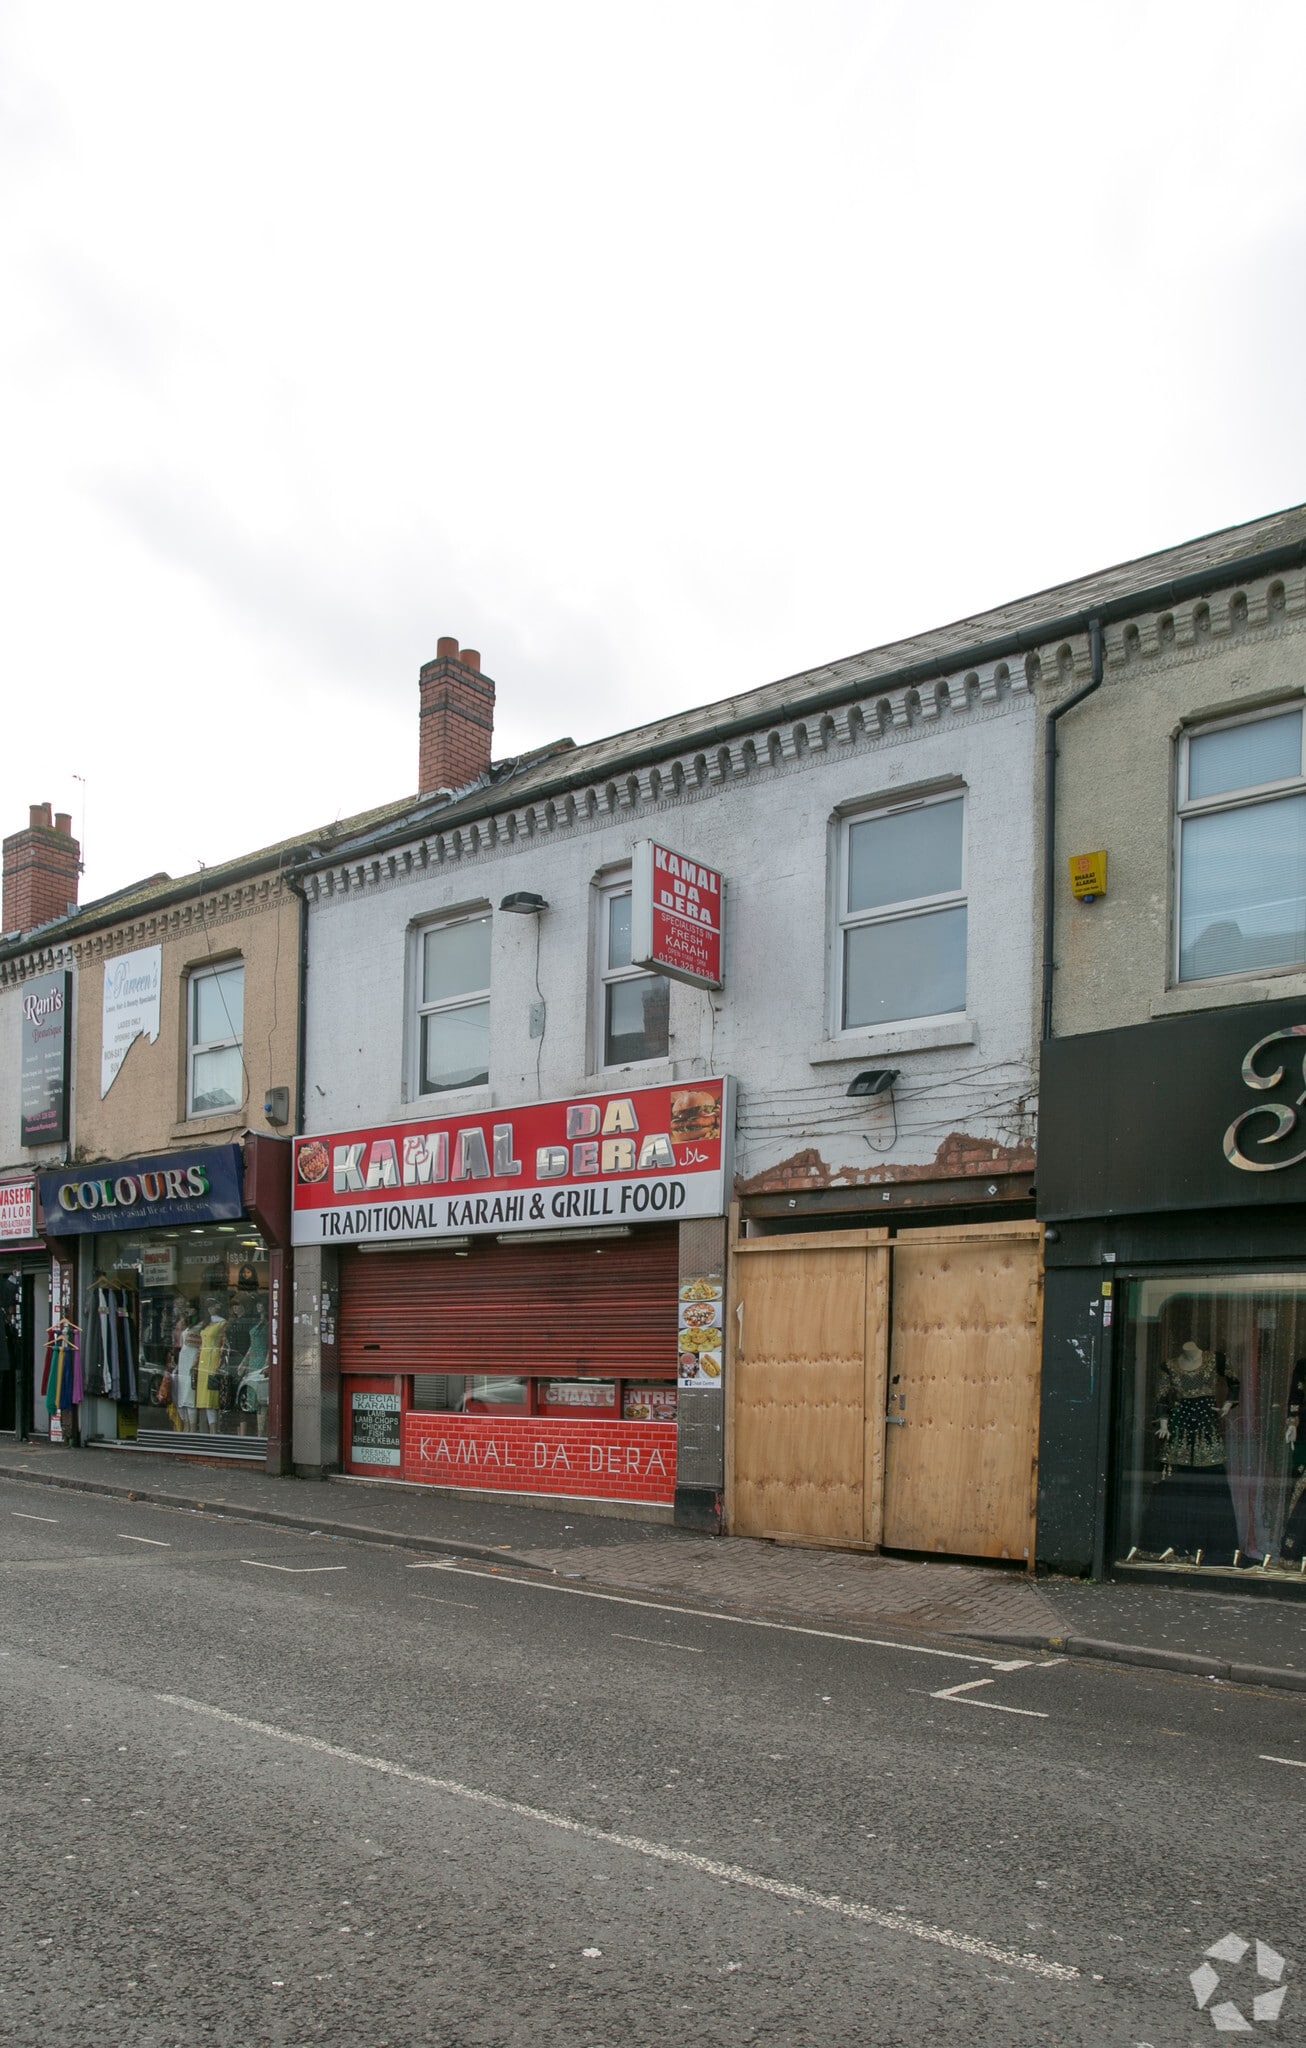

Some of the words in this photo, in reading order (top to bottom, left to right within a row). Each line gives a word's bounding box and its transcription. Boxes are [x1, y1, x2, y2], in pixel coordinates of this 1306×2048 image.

[655, 847, 719, 895] KAMAL
[673, 878, 701, 904] DA
[660, 889, 713, 925] DERA
[661, 912, 704, 938] SPECIALISTS
[705, 930, 713, 941] IN
[671, 927, 703, 947] FRESH
[665, 935, 709, 960] KARAHI
[658, 952, 679, 966] 0121
[679, 960, 694, 973] 328
[23, 986, 63, 1026] Rani's
[566, 1098, 640, 1140] DA
[333, 1123, 522, 1194] KAMAL
[536, 1132, 677, 1181] DERA
[679, 1147, 709, 1166] حلال
[58, 1165, 210, 1212] COLOURS
[320, 1203, 438, 1236] TRADITIONAL
[447, 1195, 524, 1227] KARAHI
[529, 1192, 545, 1221] &
[551, 1187, 613, 1218] GRILL
[619, 1181, 686, 1214] FOOD
[354, 1393, 399, 1403] SPECIAL
[545, 1387, 600, 1402] CHAAT
[357, 1401, 397, 1410] KARAHI
[367, 1410, 386, 1418] LAMB
[361, 1422, 392, 1431] CHICKEN
[374, 1417, 399, 1426] CHOPS
[353, 1435, 376, 1444] SHEEK
[377, 1437, 400, 1446] KEBAB
[368, 1430, 385, 1438] FISH
[360, 1448, 392, 1457] FRESHLY
[361, 1455, 391, 1464] COOKED
[420, 1437, 516, 1467] KAMAL
[534, 1442, 571, 1470] DA
[589, 1445, 667, 1477] DERA
